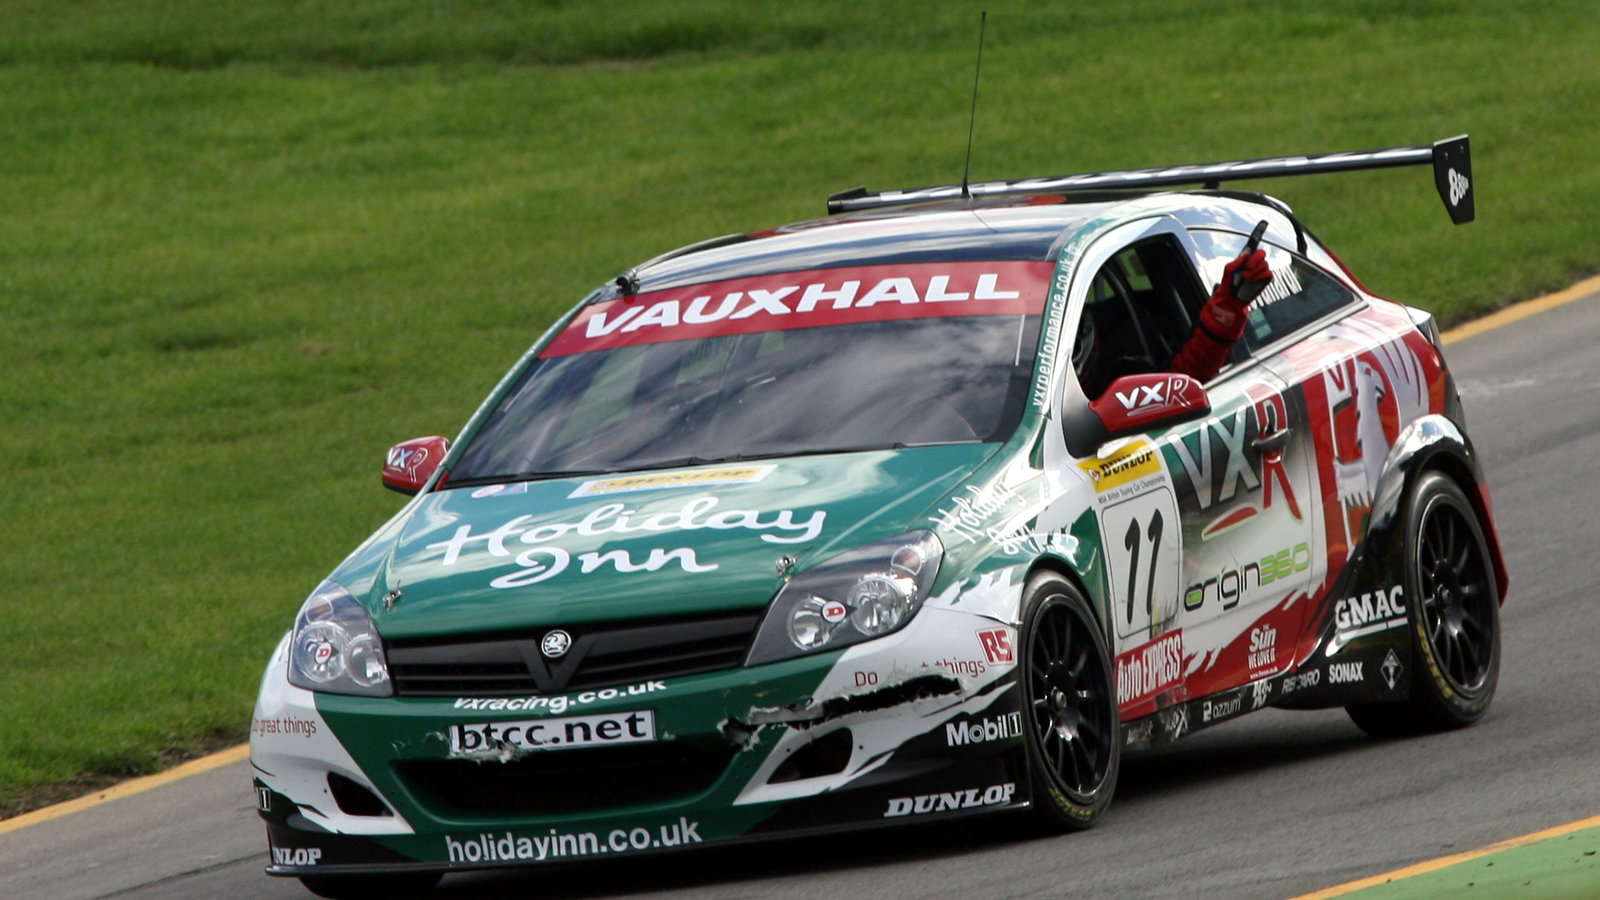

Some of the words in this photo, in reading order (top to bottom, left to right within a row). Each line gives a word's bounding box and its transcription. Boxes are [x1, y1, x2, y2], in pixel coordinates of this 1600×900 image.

[586, 273, 1020, 338] VAUXHALL
[1115, 376, 1192, 409] VXR
[386, 447, 428, 483] VXR
[1099, 450, 1154, 477] DUNLOP
[1168, 378, 1302, 520] VXR
[426, 497, 827, 566] Holiday
[490, 546, 719, 589] Inn
[1125, 508, 1164, 625] 11
[1184, 542, 1312, 612] origin360
[1335, 584, 1407, 629] GMAC
[1249, 627, 1277, 652] Sun
[854, 671, 879, 687] Do
[935, 657, 986, 678] hings
[1117, 660, 1142, 704] Auto
[1142, 634, 1181, 696] EXPRESS
[1257, 649, 1270, 668] LOVE
[1329, 662, 1364, 684] SONAX
[453, 680, 668, 714] vxracing.co.uk
[260, 717, 281, 737] great
[283, 716, 317, 738] things
[457, 712, 648, 750] btcc.net
[884, 783, 1017, 818] DUNLOP
[272, 848, 322, 865] NLOP
[445, 816, 703, 862] holidayinn.co.uk
